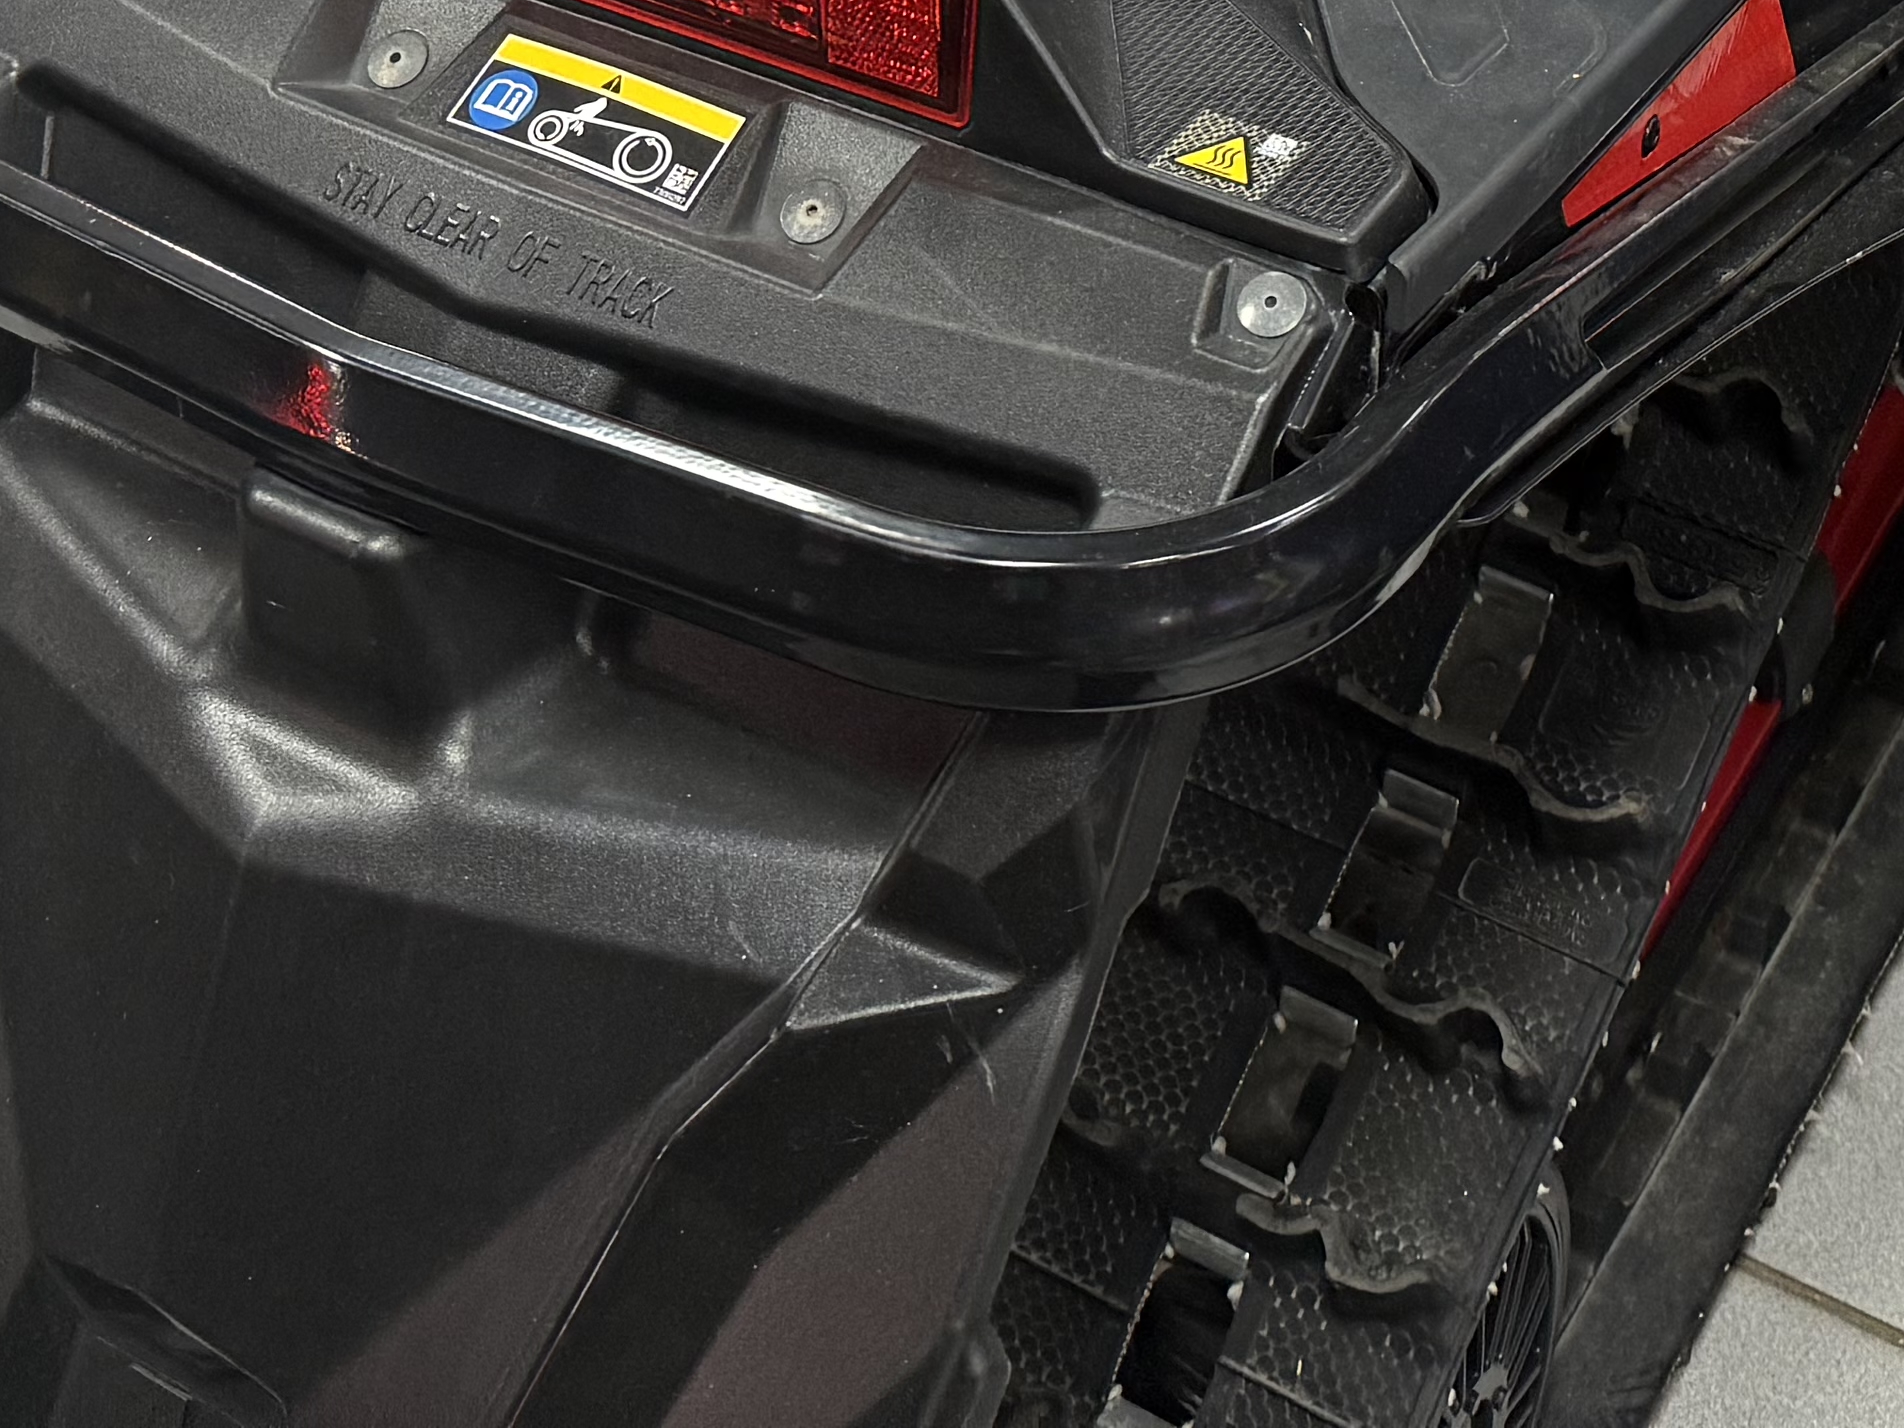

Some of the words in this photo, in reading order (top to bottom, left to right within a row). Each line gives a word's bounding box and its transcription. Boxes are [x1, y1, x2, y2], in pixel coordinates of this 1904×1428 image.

[322, 160, 395, 219] STAY
[404, 191, 501, 259] CLEAR
[508, 229, 561, 279] OF
[566, 251, 677, 329] TRACK
